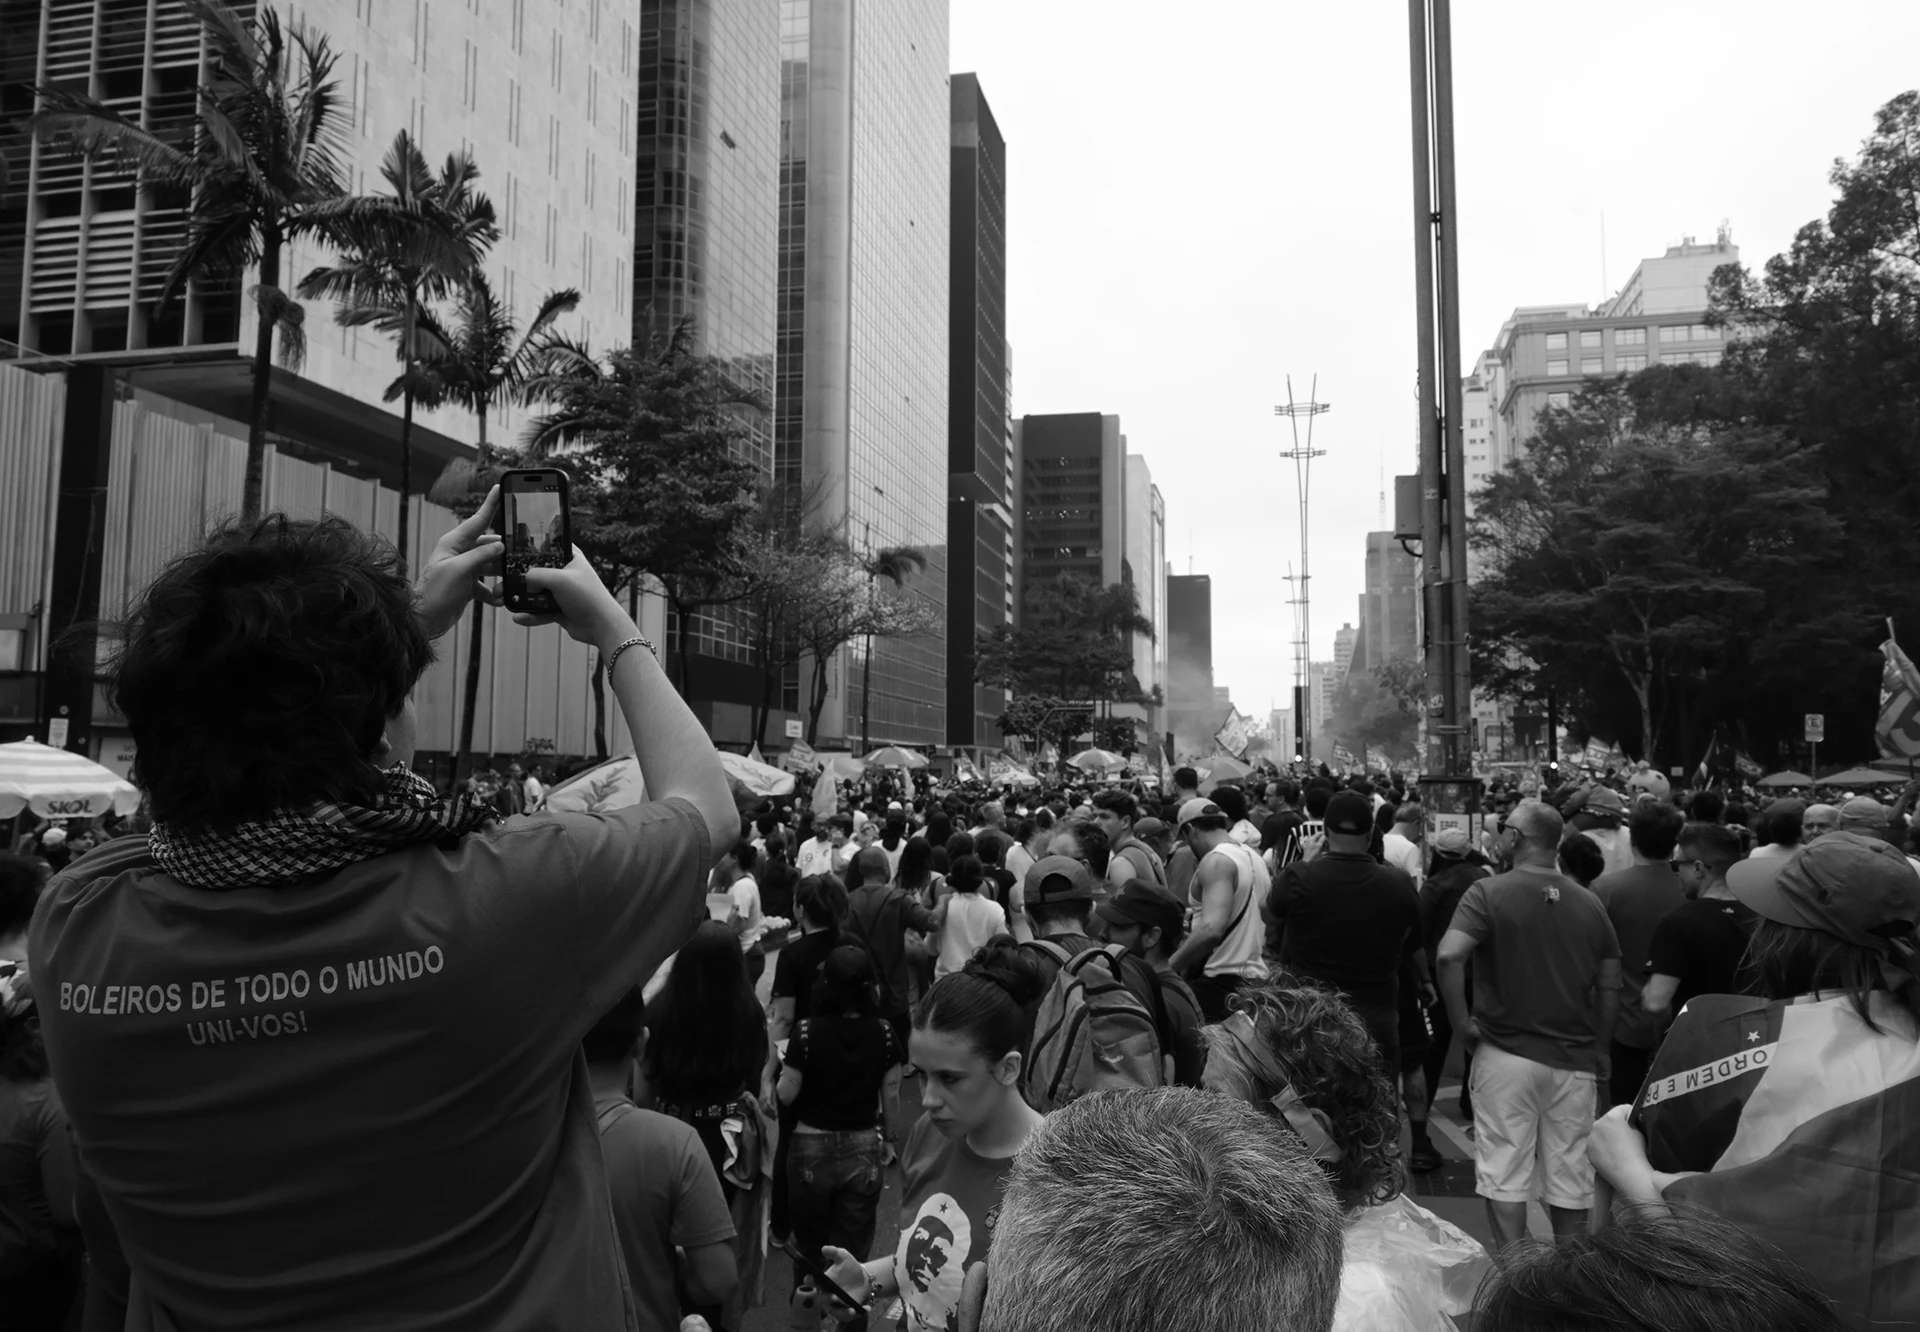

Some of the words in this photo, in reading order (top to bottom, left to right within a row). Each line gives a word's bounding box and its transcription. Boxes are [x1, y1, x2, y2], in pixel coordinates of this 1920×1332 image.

[48, 800, 92, 814] SKOL
[60, 981, 182, 1015] BOLEIROS
[192, 980, 226, 1009] DE
[235, 968, 311, 1004] TODO
[319, 966, 339, 995] O
[347, 945, 444, 990] MUNDO
[186, 1010, 308, 1046] UNI-VOS!
[1667, 1079, 1676, 1093] E
[1686, 1050, 1768, 1090] ORDEM
